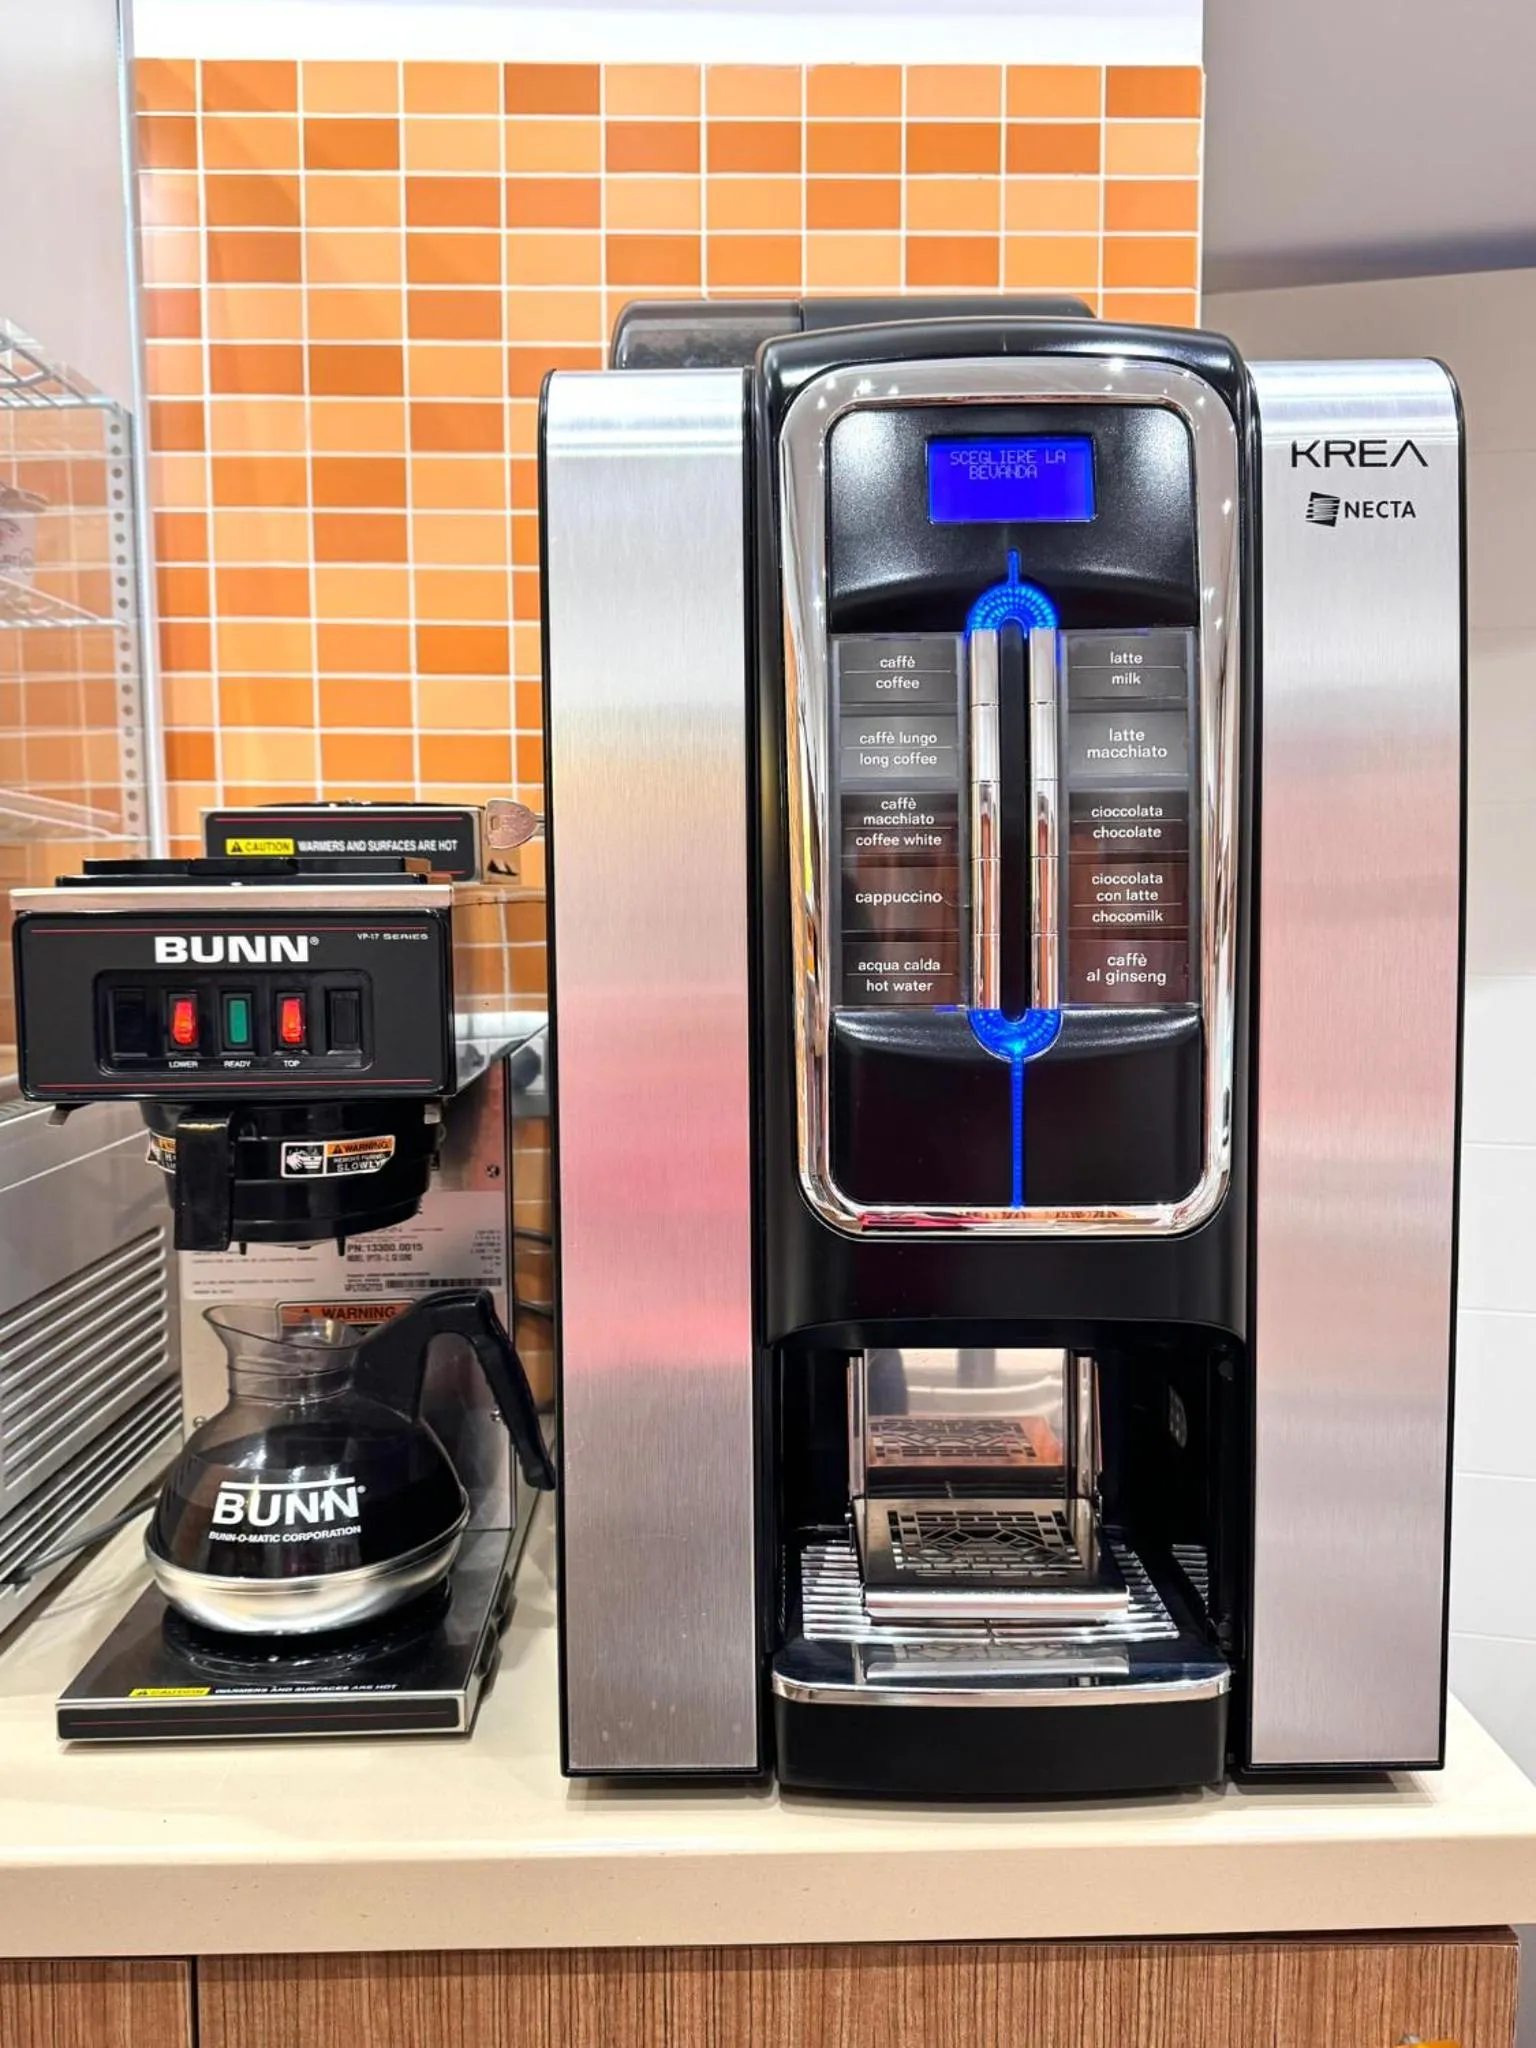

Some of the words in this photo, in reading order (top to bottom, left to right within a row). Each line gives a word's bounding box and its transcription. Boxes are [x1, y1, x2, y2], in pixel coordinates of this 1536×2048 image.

[950, 449, 1037, 466] SCEGLIERE
[1045, 449, 1066, 464] LA
[1291, 439, 1429, 468] KREA
[968, 464, 1037, 480] BEVANDA
[1344, 500, 1416, 519] NECTA
[880, 655, 916, 668] caffè
[1110, 652, 1143, 664] latte
[875, 676, 920, 689] coffee
[1111, 672, 1141, 685] milk
[859, 731, 895, 744] caffè
[899, 731, 938, 747] lungo
[1109, 728, 1145, 742] latte
[1087, 744, 1168, 759] macchiato
[859, 752, 889, 769] long
[893, 752, 937, 765] coffee
[881, 797, 917, 810] caffè
[1091, 804, 1163, 818] cioccolata
[863, 812, 935, 825] macchiato
[855, 832, 900, 846] coffee
[903, 833, 942, 846] white
[1093, 825, 1162, 839] chocolate
[245, 841, 290, 852] CAUTION
[298, 840, 345, 853] WARMERS
[347, 840, 367, 852] AND
[368, 839, 417, 852] SURFACES
[418, 839, 437, 851] ARE
[439, 839, 458, 851] HOT
[1091, 872, 1163, 886] cioccolata
[855, 890, 943, 906] cappuccino
[1096, 891, 1122, 902] con
[1126, 888, 1159, 901] latte
[1092, 909, 1163, 923] chocomilk
[357, 933, 379, 941] VP-17
[382, 933, 429, 941] SERIES
[858, 961, 900, 973] acqua
[903, 958, 941, 971] calda
[1107, 952, 1147, 967] caffè
[1086, 969, 1101, 982] al
[1105, 969, 1167, 986] ginseng
[866, 979, 889, 992] hot
[892, 980, 933, 992] water
[168, 1060, 199, 1069] LOWER
[223, 1060, 251, 1069] READY
[283, 1060, 301, 1068] TOP
[321, 1306, 396, 1320] WARNING
[208, 1530, 281, 1543] BUNN-O-MATIC
[282, 1525, 362, 1543] CORPORATION
[294, 1685, 349, 1693] SURFACES
